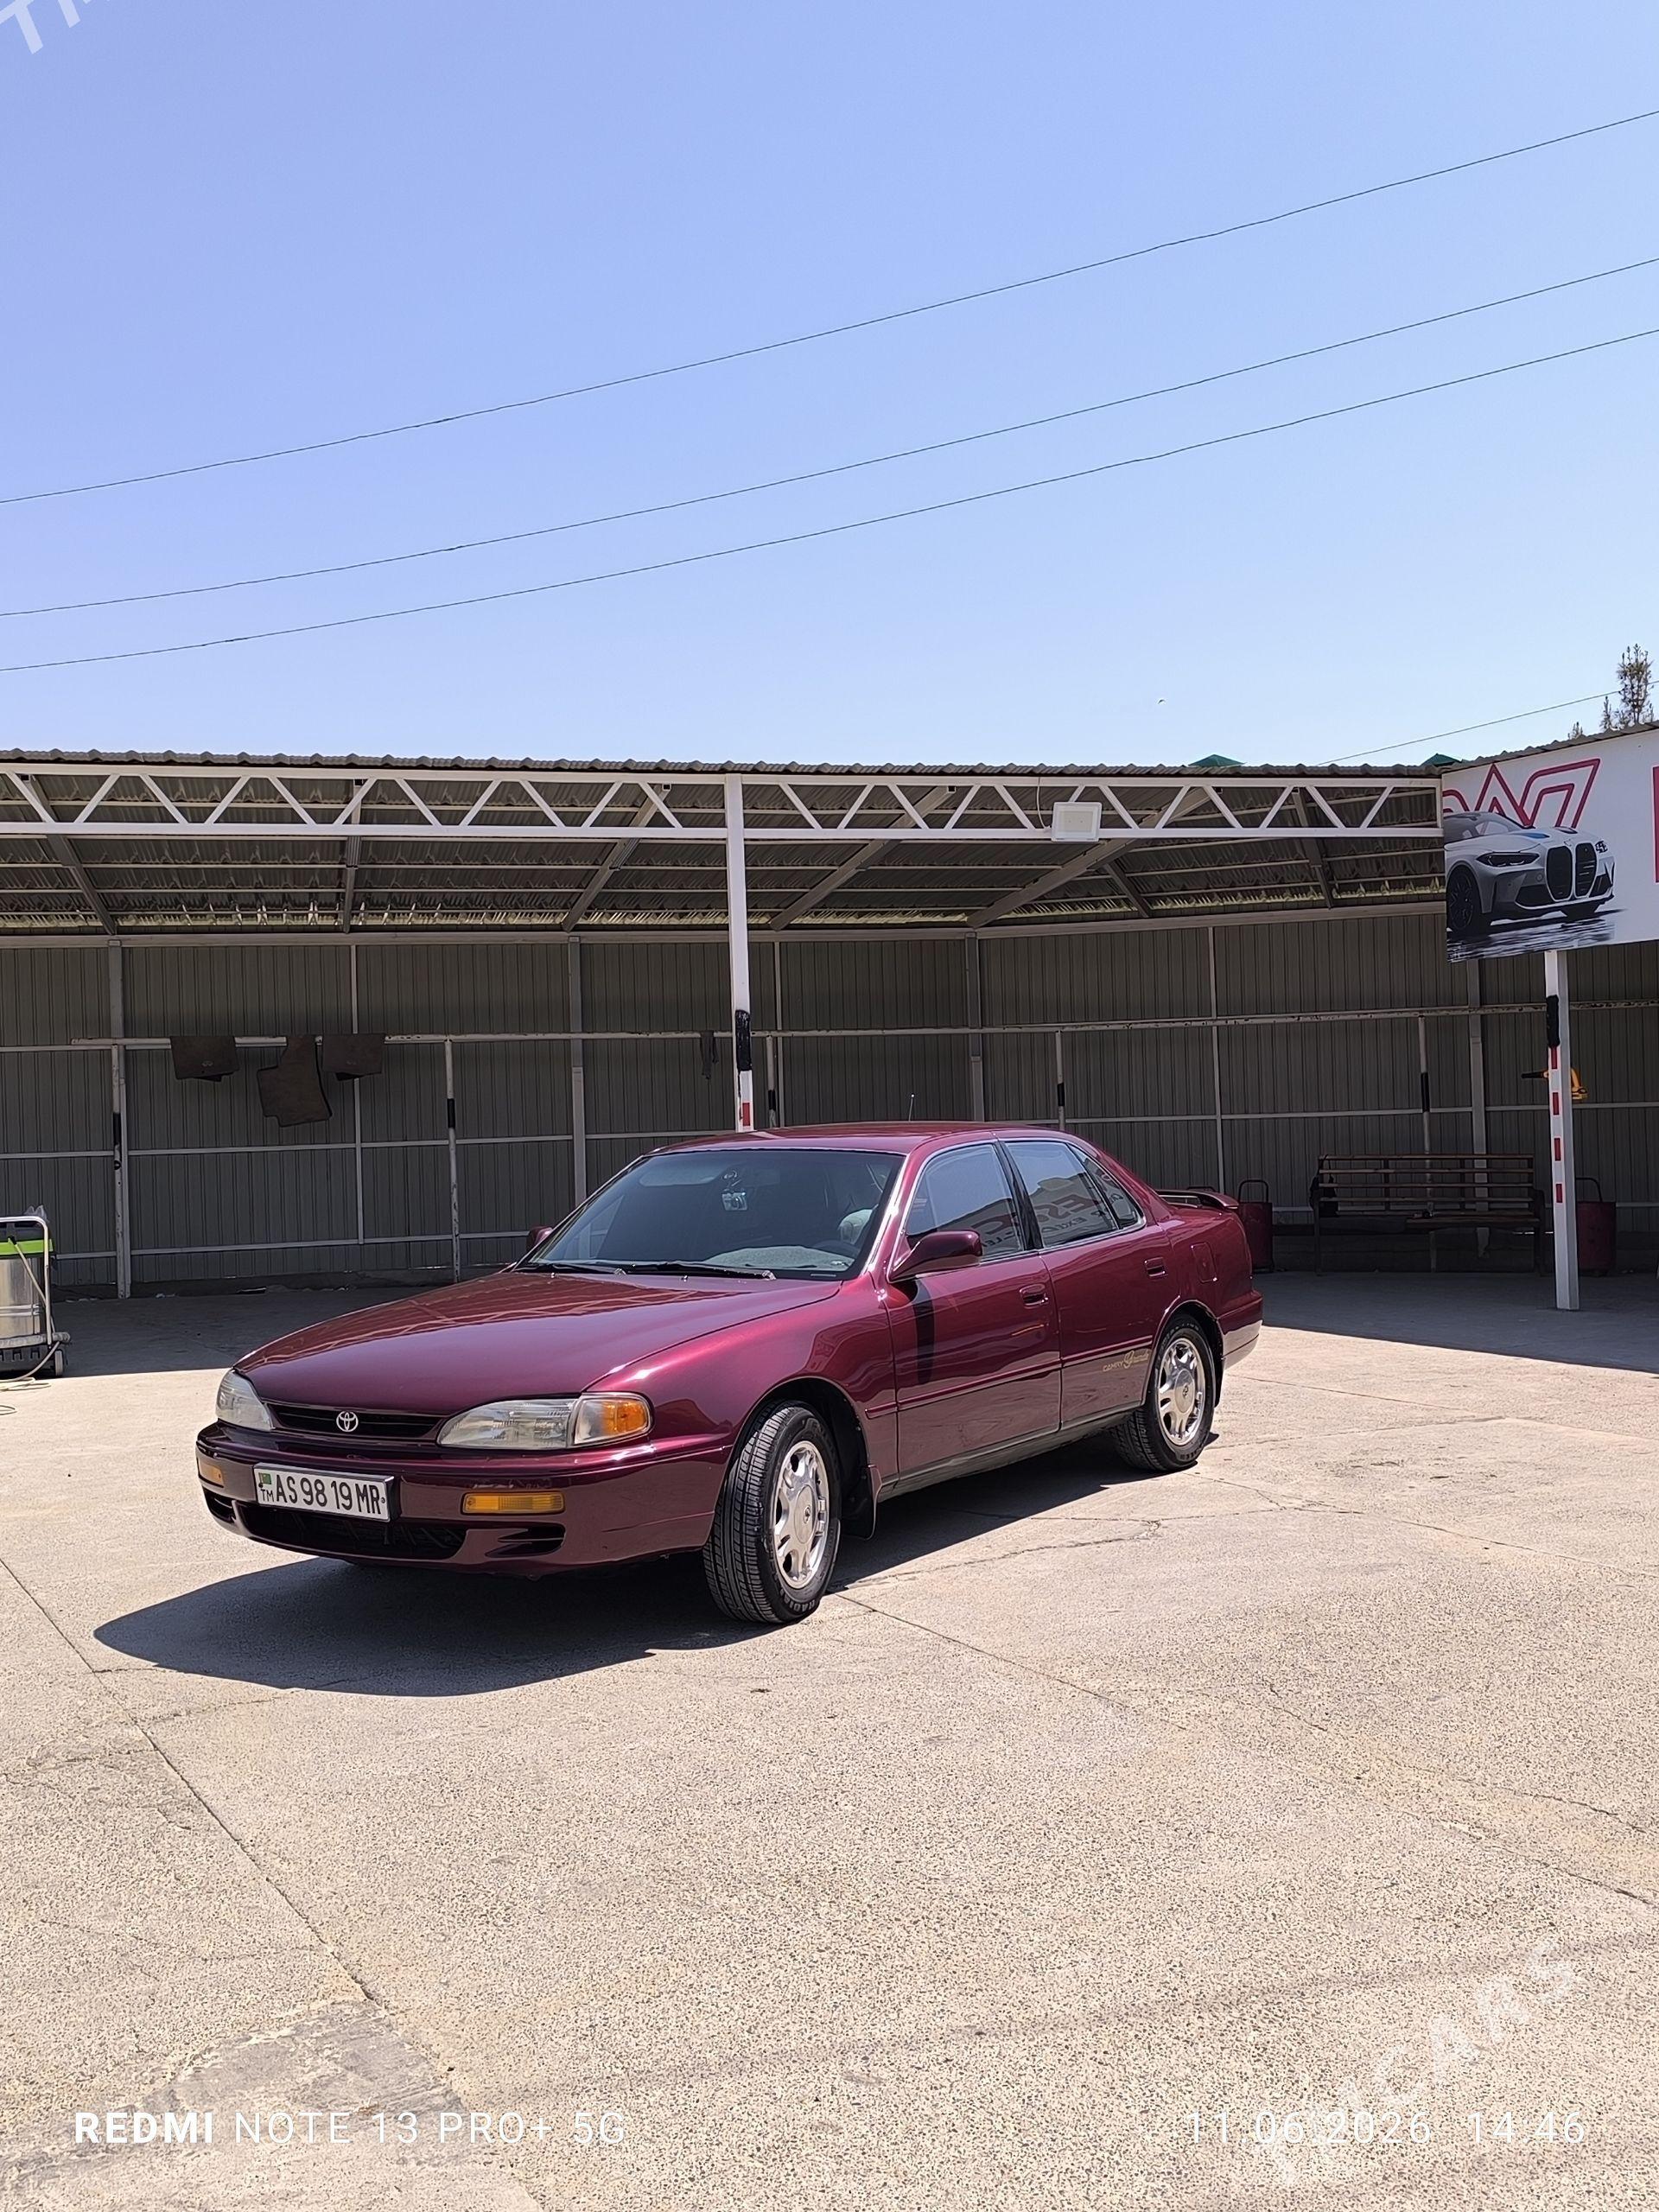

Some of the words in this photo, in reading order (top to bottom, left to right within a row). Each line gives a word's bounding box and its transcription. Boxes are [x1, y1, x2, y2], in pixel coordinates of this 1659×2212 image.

[260, 1489, 275, 1503] TM
[276, 1474, 298, 1504] AS
[300, 1477, 327, 1507] 98
[331, 1480, 353, 1511] 19
[354, 1483, 382, 1515] MR
